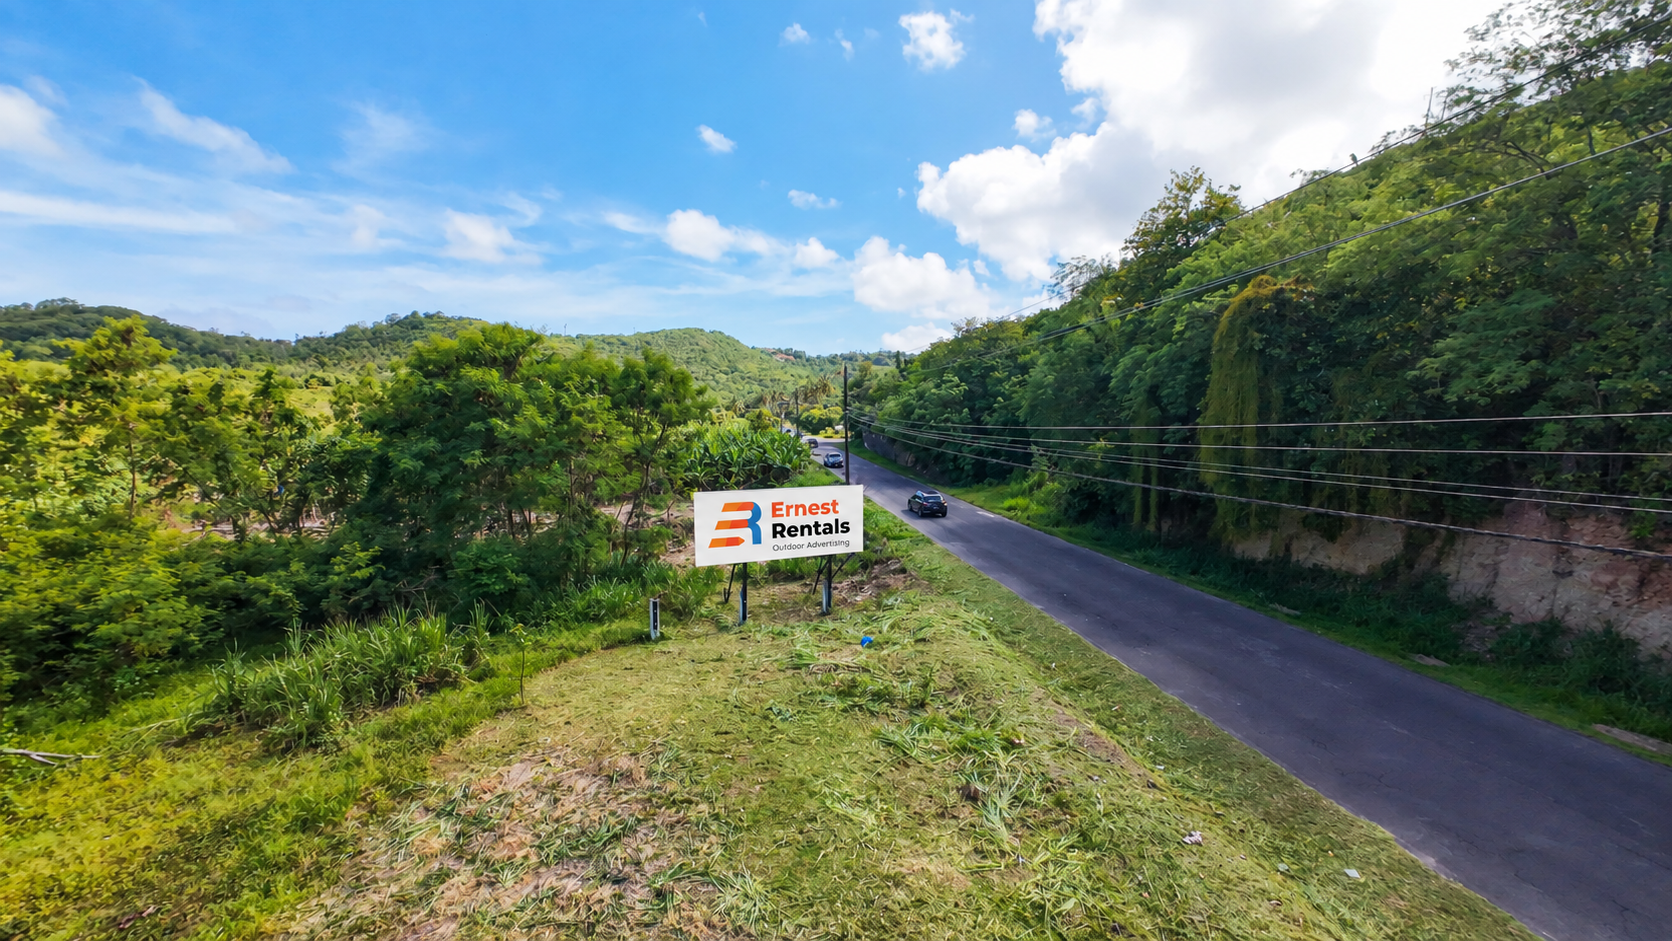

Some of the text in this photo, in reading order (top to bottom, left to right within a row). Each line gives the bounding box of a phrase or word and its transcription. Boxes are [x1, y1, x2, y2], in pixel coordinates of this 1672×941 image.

[771, 499, 840, 518] Ernest
[772, 518, 851, 539] Rentals
[772, 539, 850, 552] Outdoor Advertising
